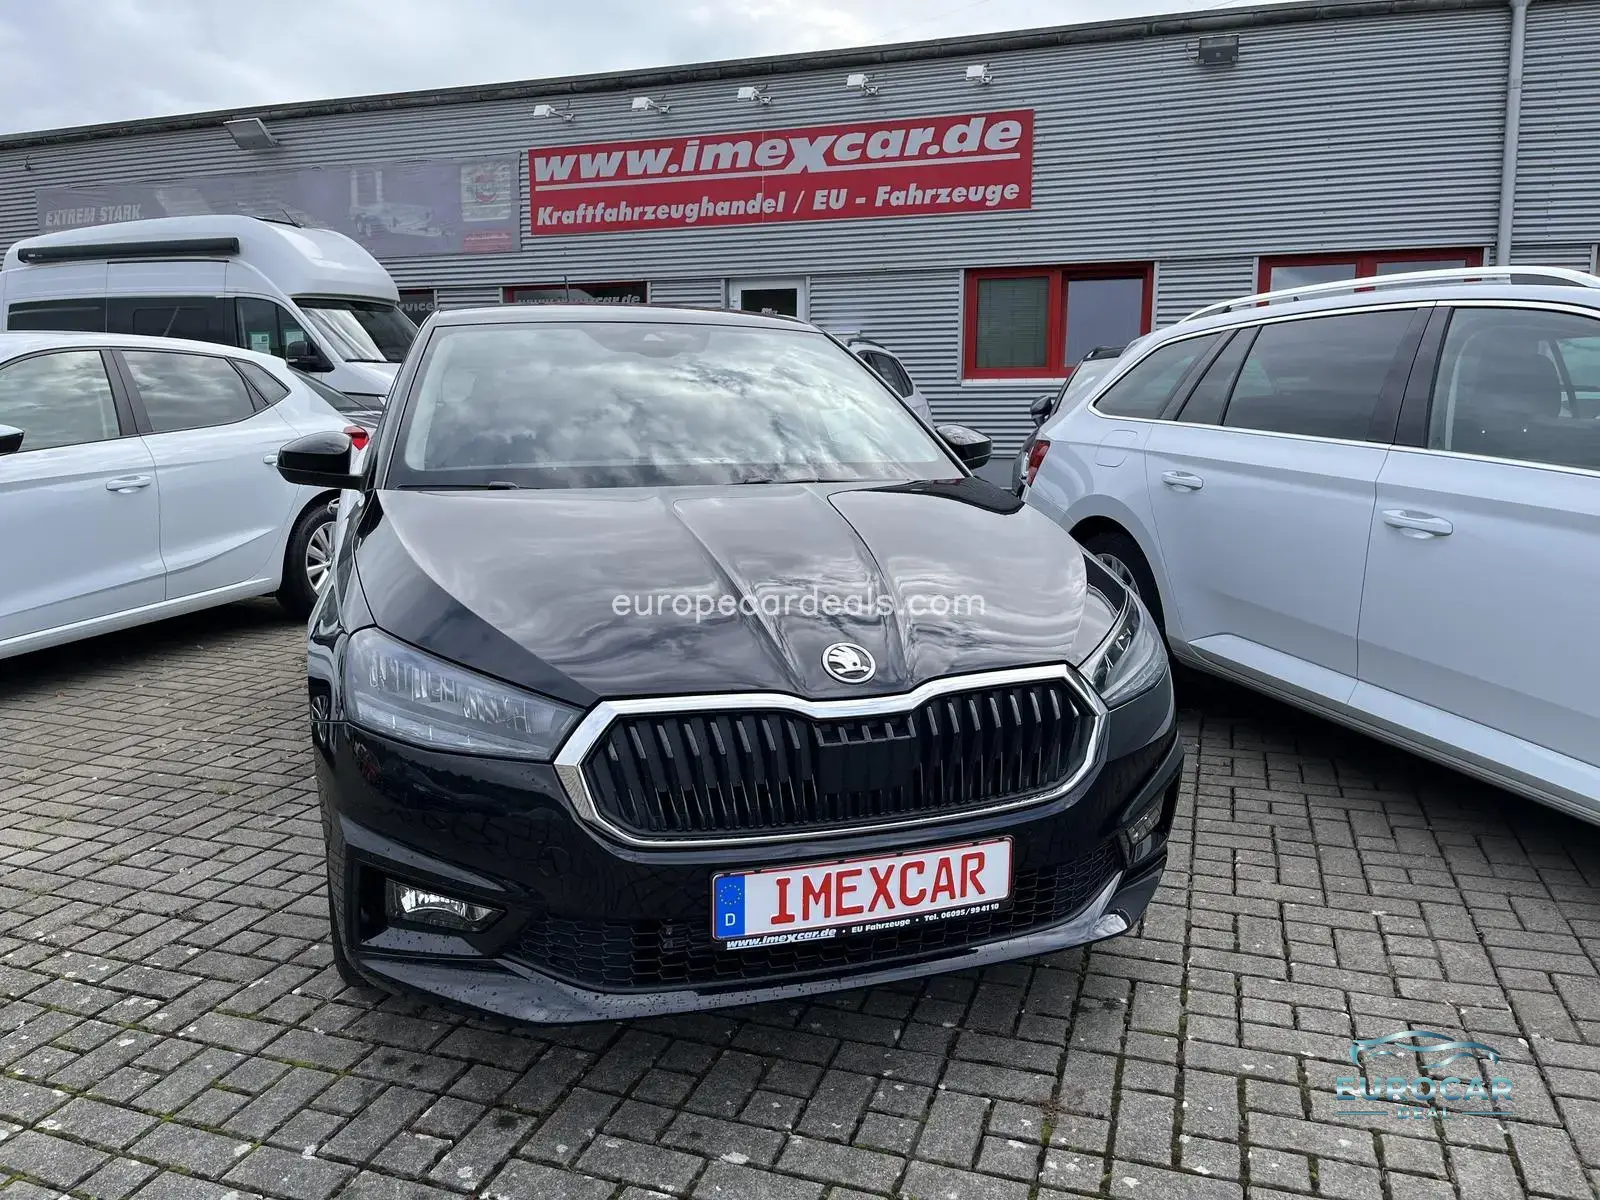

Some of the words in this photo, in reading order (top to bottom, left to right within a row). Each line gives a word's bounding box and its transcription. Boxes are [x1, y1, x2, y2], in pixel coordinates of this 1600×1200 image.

[533, 116, 1023, 181] www.imexcar.de
[45, 207, 95, 226] EXTREM
[536, 191, 786, 227] Kraftfahrzeughandel
[792, 190, 805, 214] /
[812, 188, 848, 212] EU
[875, 181, 1020, 207] Fahrzeuge
[770, 851, 986, 925] IMEXCAR
[725, 913, 735, 927] D
[726, 927, 837, 950] www.imexcar.de
[851, 925, 864, 934] EU
[865, 918, 911, 932] Fahrzeuge
[924, 913, 939, 922] Tel.
